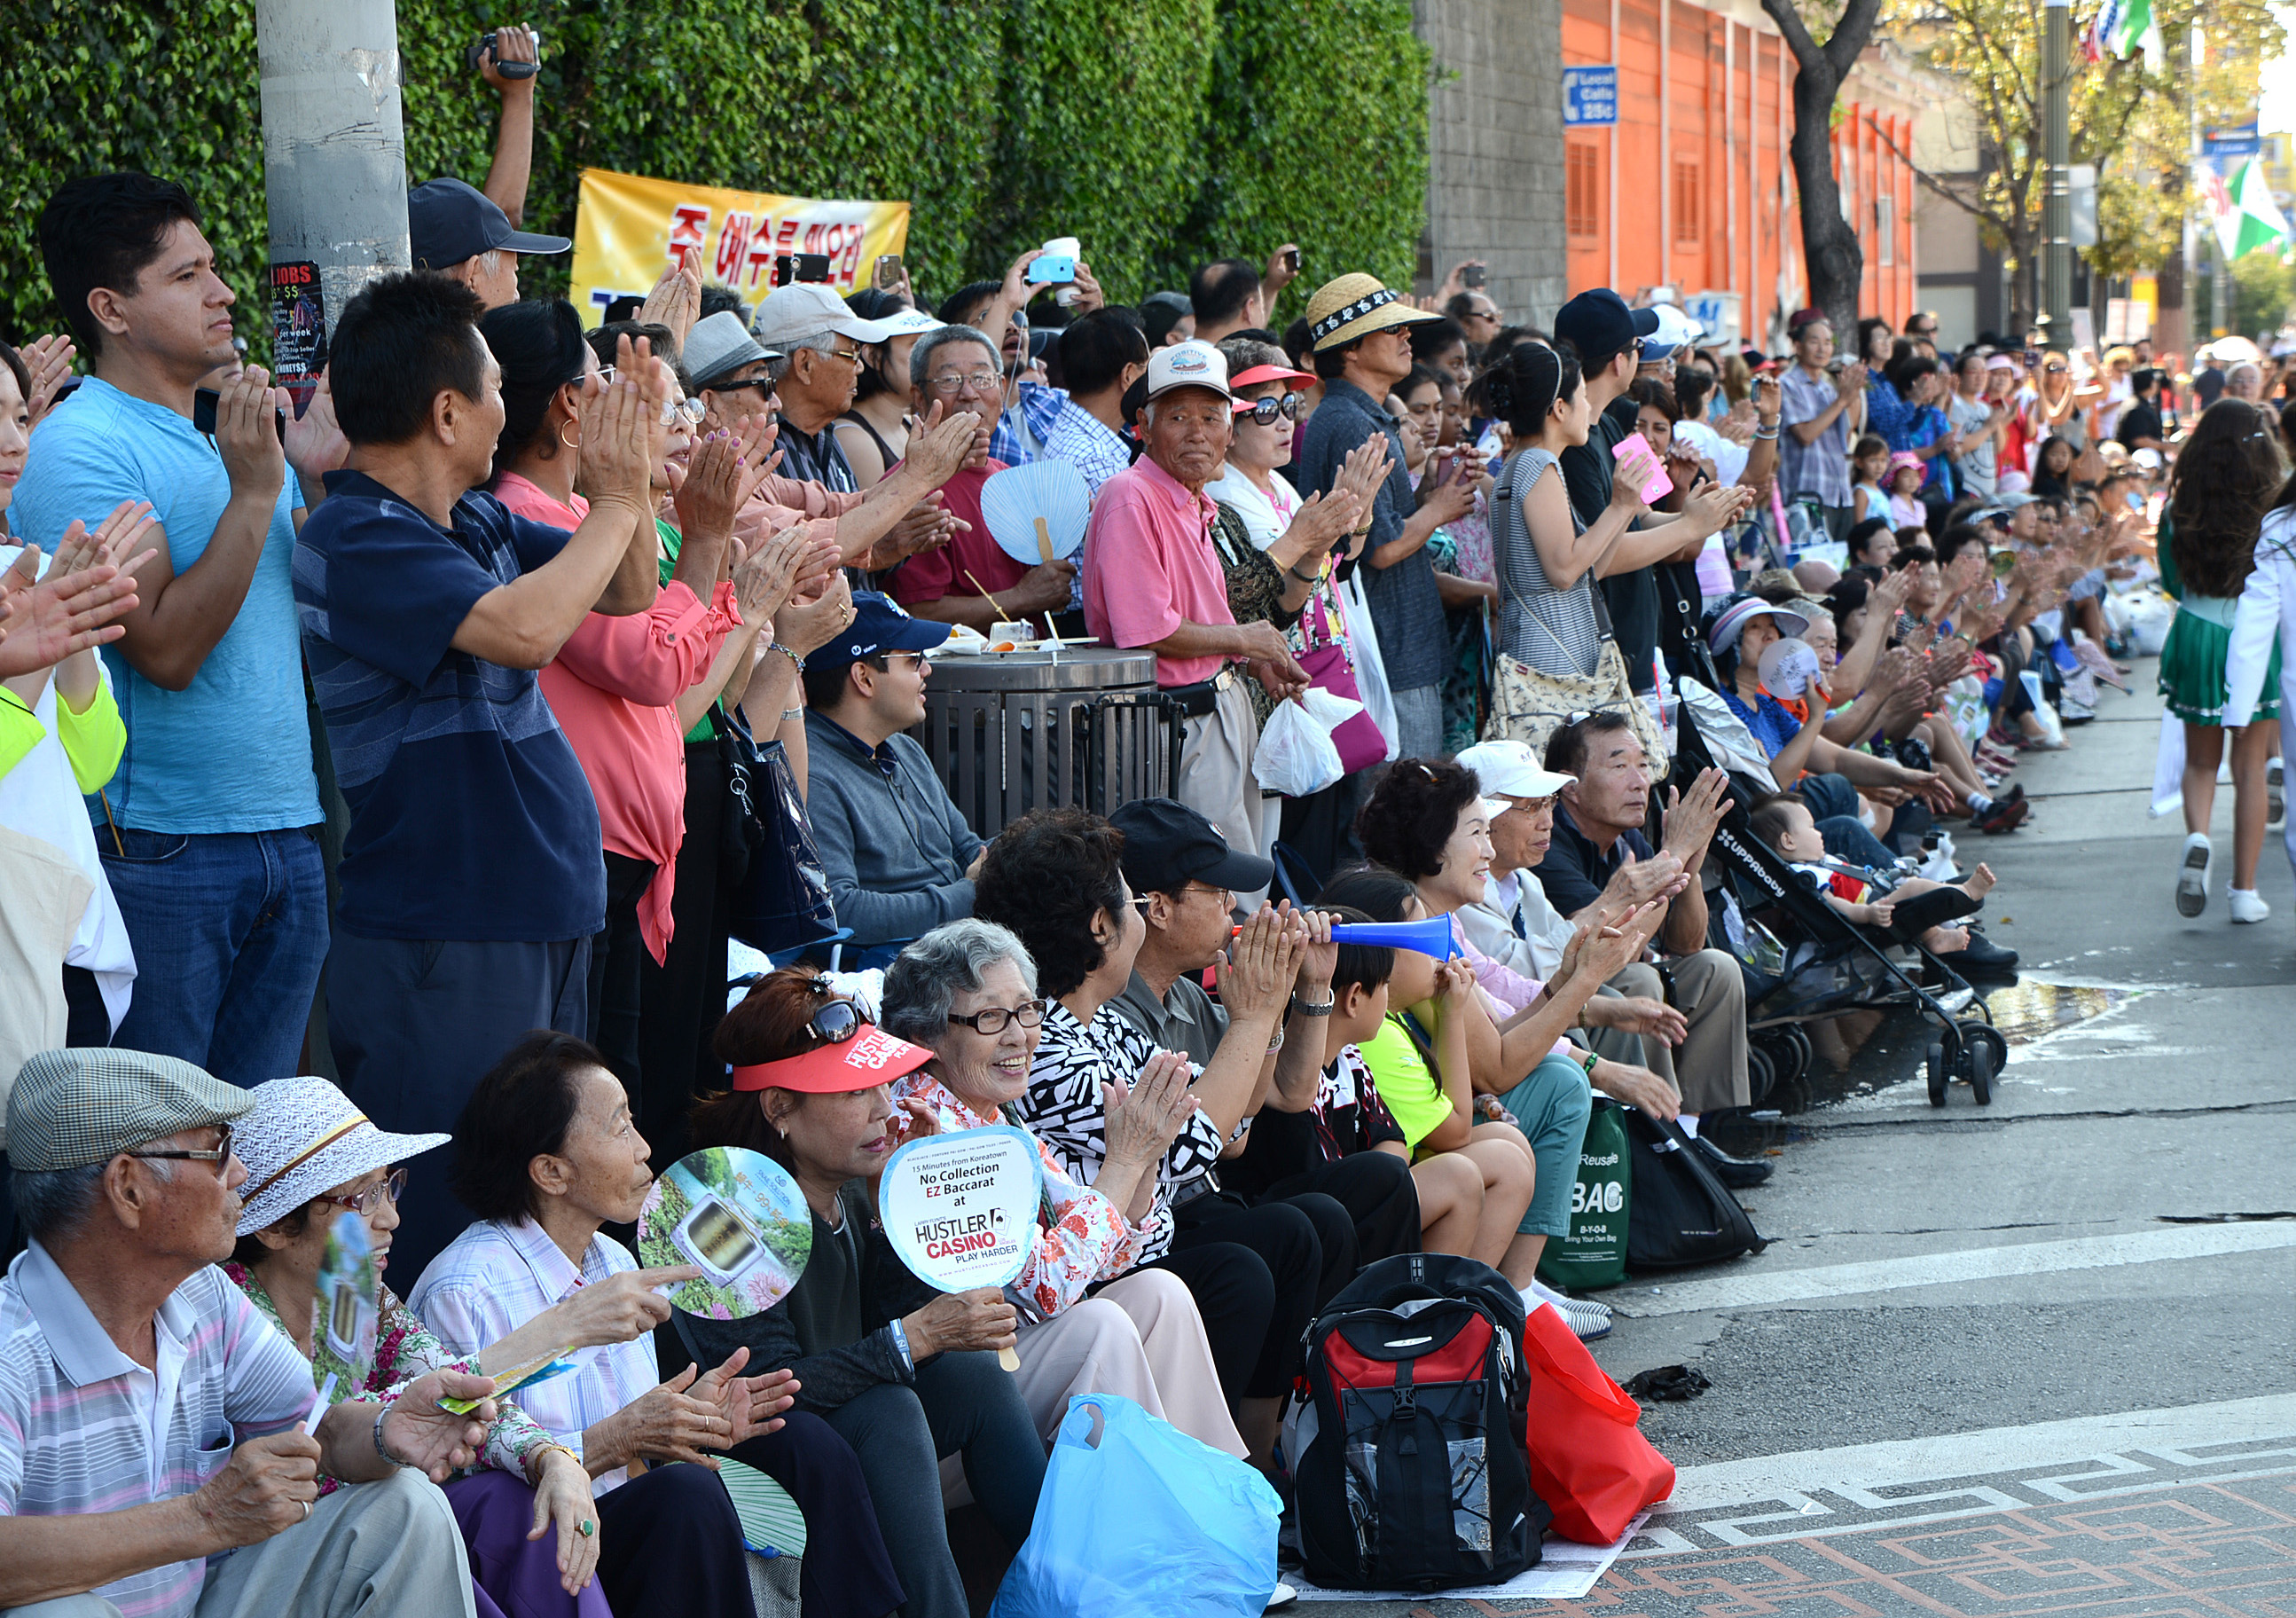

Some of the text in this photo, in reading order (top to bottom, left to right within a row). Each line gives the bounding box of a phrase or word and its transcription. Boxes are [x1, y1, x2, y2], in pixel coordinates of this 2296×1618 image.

[1579, 72, 1613, 85] Local
[1581, 87, 1614, 101] Calls
[276, 265, 311, 285] JOBS
[290, 328, 311, 337] week
[863, 644, 877, 653] Metro
[1731, 841, 1786, 898] UPPAbaby
[922, 1162, 950, 1171] Minutes
[970, 1151, 1007, 1162] Koreatown
[920, 1163, 999, 1185] No Collection
[926, 1177, 994, 1198] EZ Baccarat
[1571, 1181, 1623, 1213] BAG
[954, 1196, 966, 1207] at
[915, 1214, 987, 1243] HUSTLER
[927, 1232, 996, 1259] CASINO
[1565, 1235, 1580, 1244] Bring
[1606, 1235, 1617, 1243] Bag
[955, 1245, 1018, 1264] PLAY HARDER
